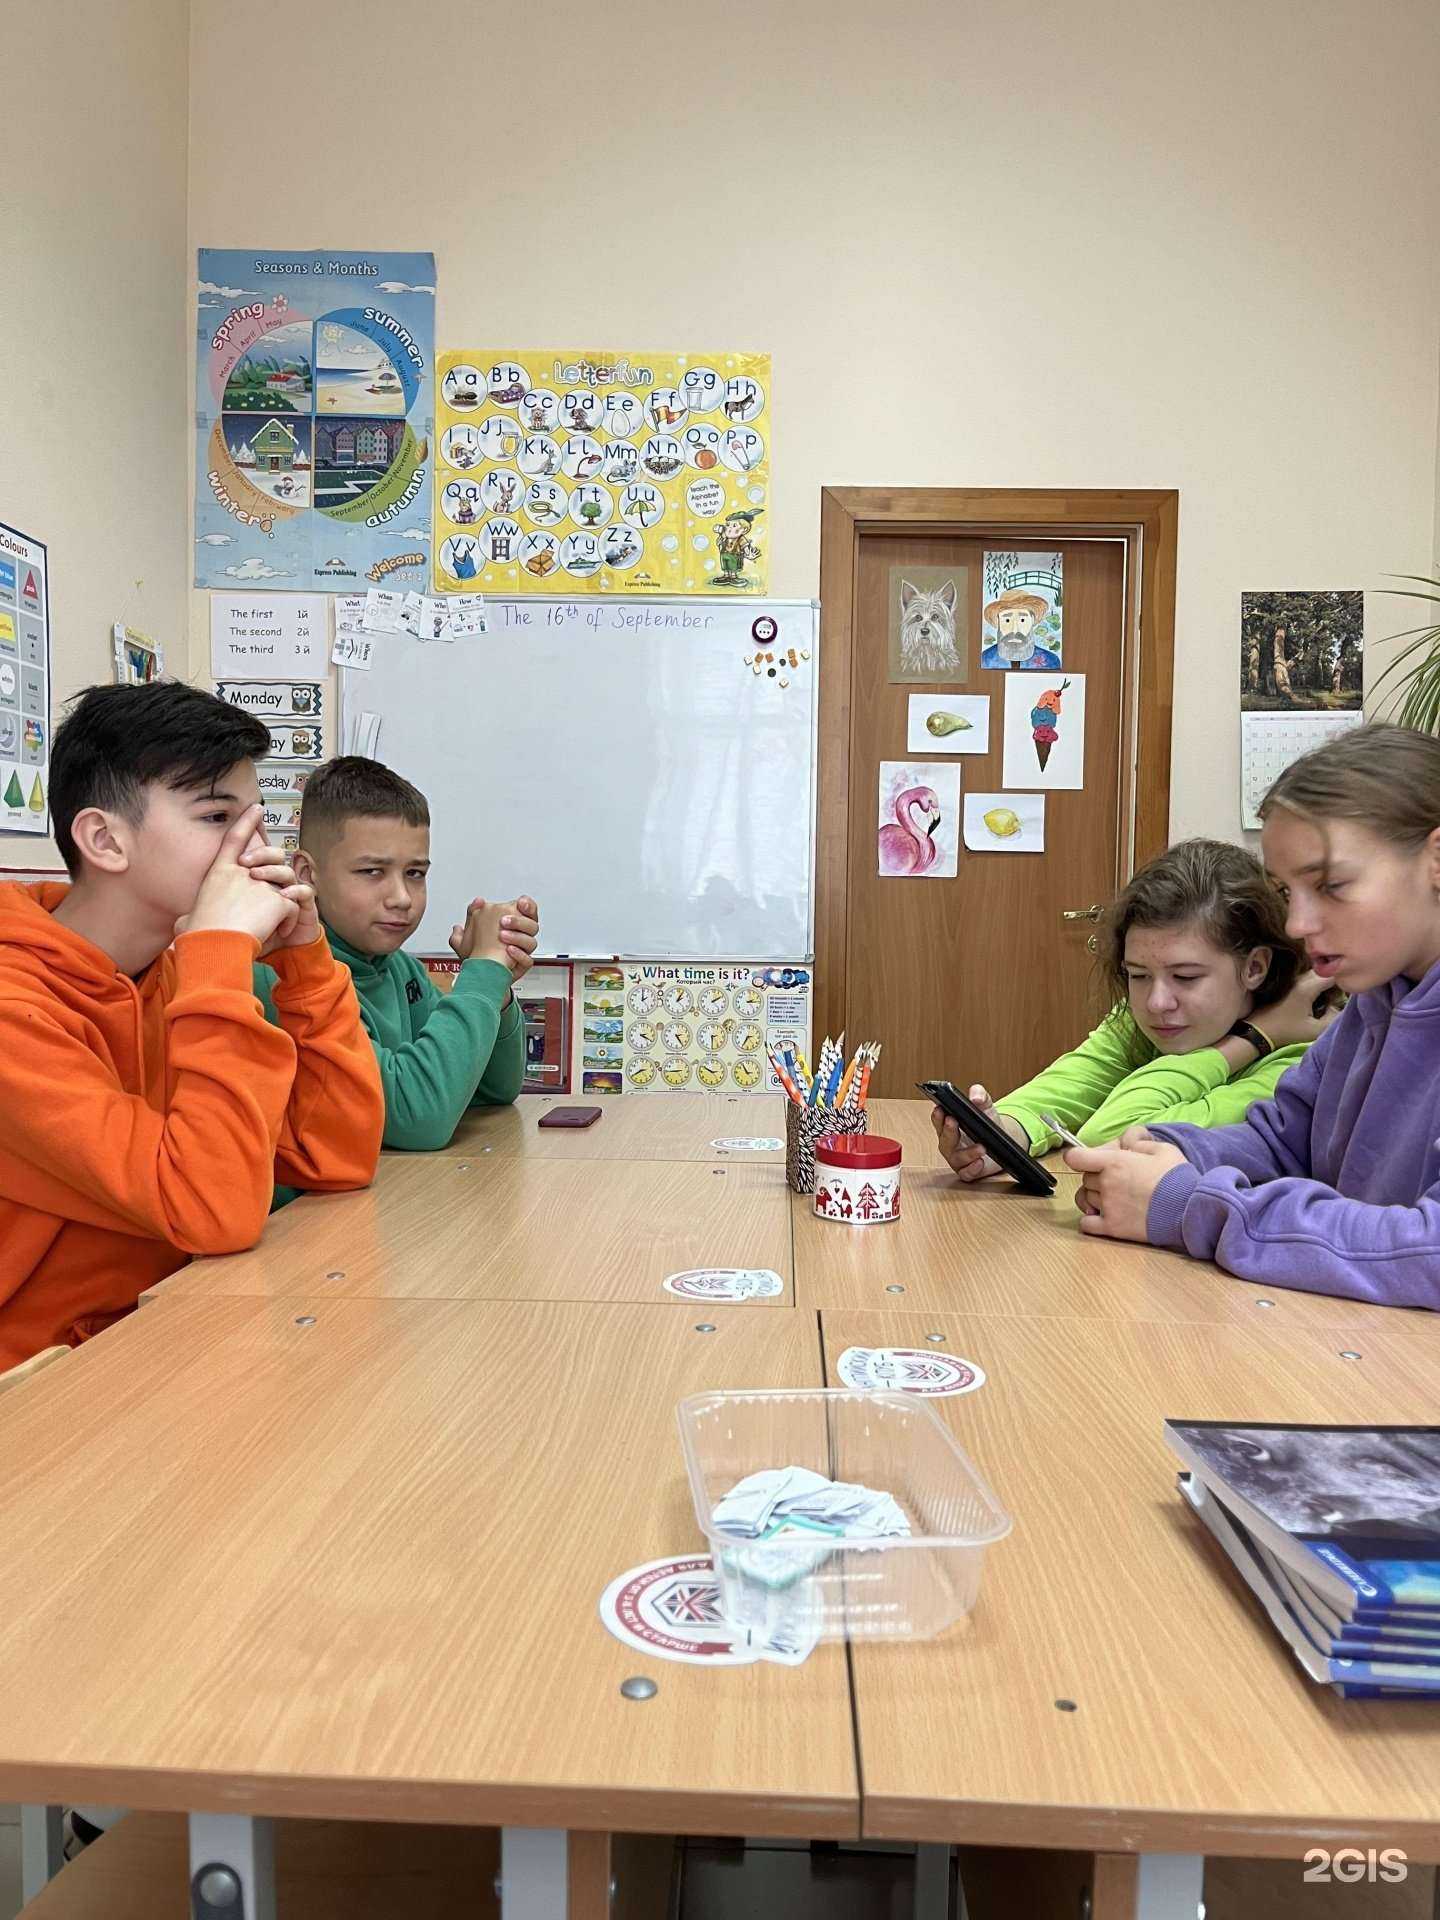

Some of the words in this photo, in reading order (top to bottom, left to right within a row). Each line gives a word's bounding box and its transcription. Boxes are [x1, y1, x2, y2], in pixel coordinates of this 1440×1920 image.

[255, 260, 308, 274] Seasons
[312, 261, 323, 274] &
[328, 261, 378, 275] Months
[211, 302, 264, 350] spring
[363, 306, 424, 369] summer
[219, 356, 235, 378] March
[553, 359, 655, 388] Letterfun
[393, 440, 413, 476] November
[207, 470, 261, 526] winter
[365, 468, 425, 527] autumn
[370, 477, 394, 501] October
[691, 492, 719, 501] Alphabet
[329, 496, 370, 517] September
[0, 534, 29, 558] Colours
[365, 553, 426, 582] Welcome
[230, 609, 248, 618] The
[251, 608, 273, 619] first
[501, 604, 533, 626] The
[586, 607, 606, 632] of
[611, 607, 714, 633] September
[229, 626, 247, 636] The
[249, 627, 282, 637] second
[228, 644, 247, 653] The
[249, 644, 274, 654] third
[229, 691, 283, 708] Monday
[258, 774, 290, 790] esday
[432, 963, 450, 971] MY
[642, 966, 680, 979] What
[684, 967, 715, 979] time
[718, 967, 729, 980] is
[733, 967, 750, 980] it?
[641, 1629, 699, 1653] СТАРШЕ
